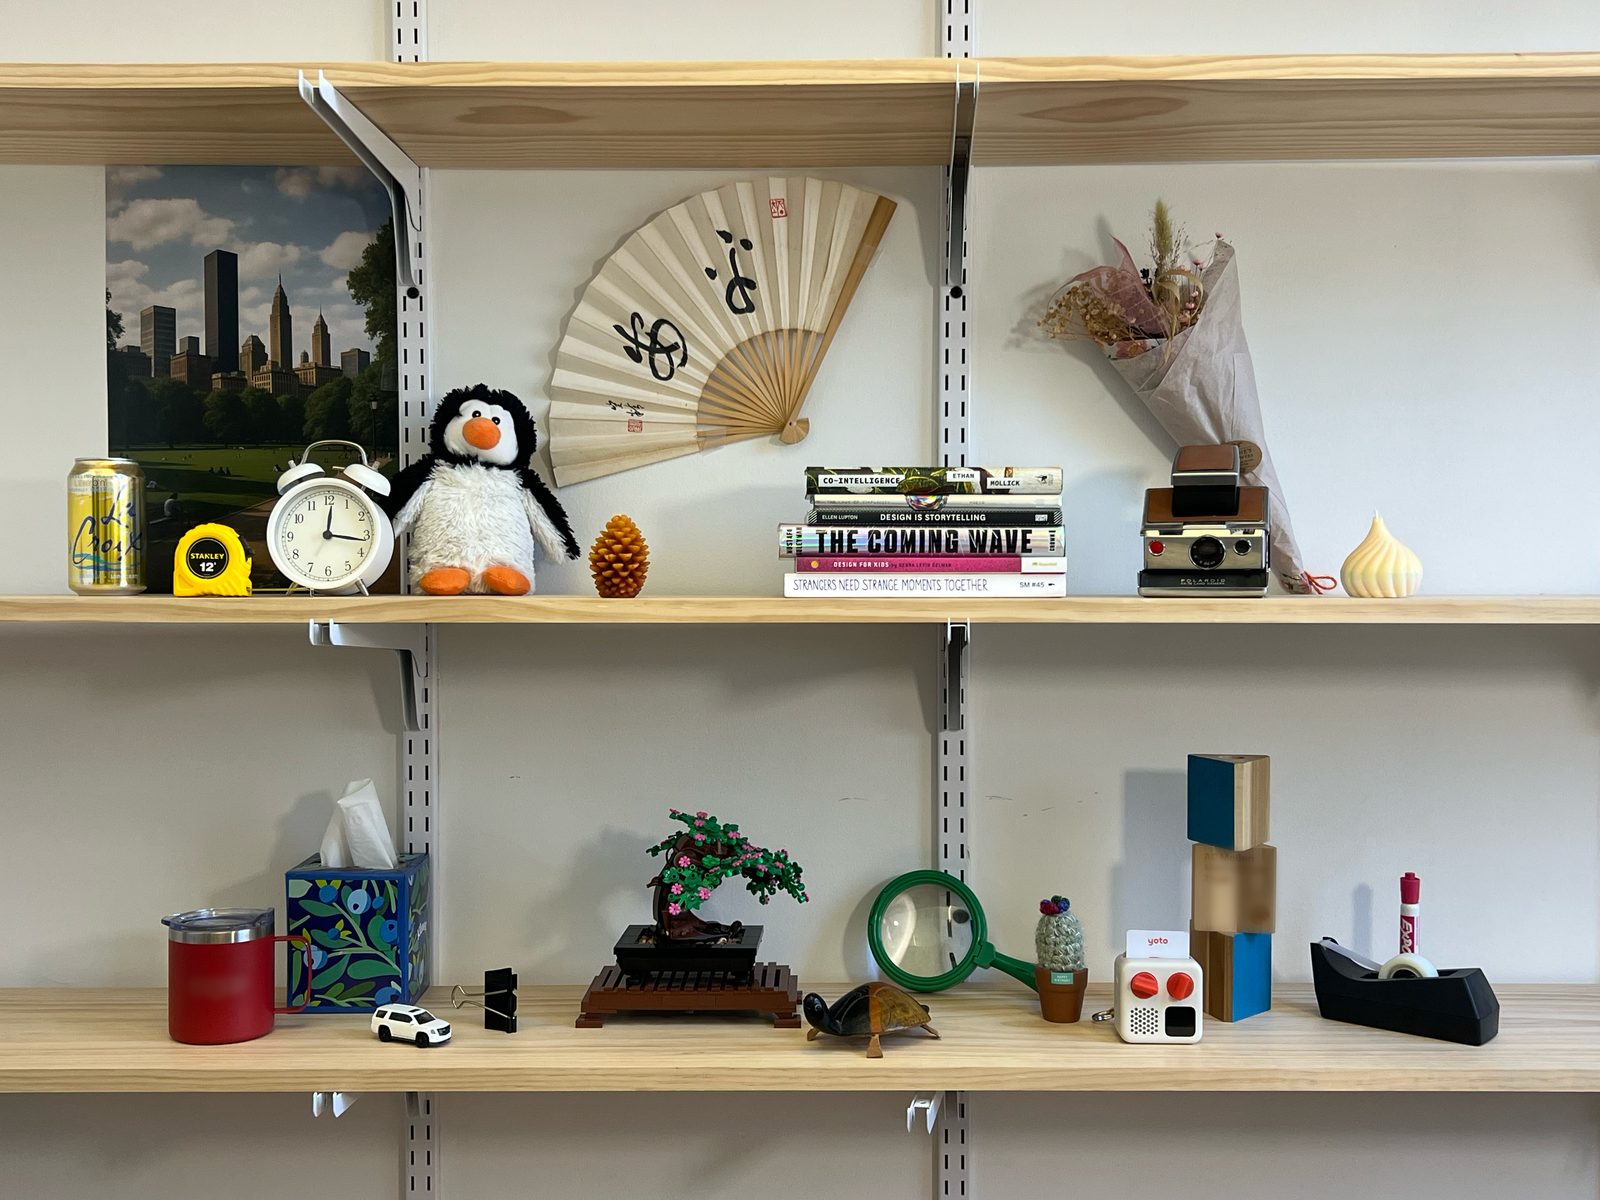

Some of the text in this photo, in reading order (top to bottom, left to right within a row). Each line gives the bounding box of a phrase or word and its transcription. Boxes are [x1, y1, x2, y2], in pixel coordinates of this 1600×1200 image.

[823, 477, 900, 485] CO-INTELLIGENCE
[324, 495, 335, 506] 12
[345, 499, 349, 509] 1
[307, 501, 316, 511] 11
[295, 514, 304, 524] 10
[358, 512, 365, 521] 2
[880, 513, 912, 521] DESIGN
[72, 516, 144, 564] Croix
[287, 532, 294, 542] 9
[363, 530, 371, 541] 3
[816, 529, 1033, 554] THE COMING WAVE
[292, 549, 300, 559] 8
[357, 547, 365, 558] 4
[307, 562, 314, 573] 7
[324, 566, 332, 576] 6
[344, 561, 352, 571] 5
[793, 579, 837, 591] STRANGERS
[838, 579, 860, 591] NEED
[862, 579, 899, 591] STRANGE
[901, 579, 942, 591] MOMENTS
[944, 579, 988, 591] TOGETHER
[1147, 937, 1169, 946] yoto
